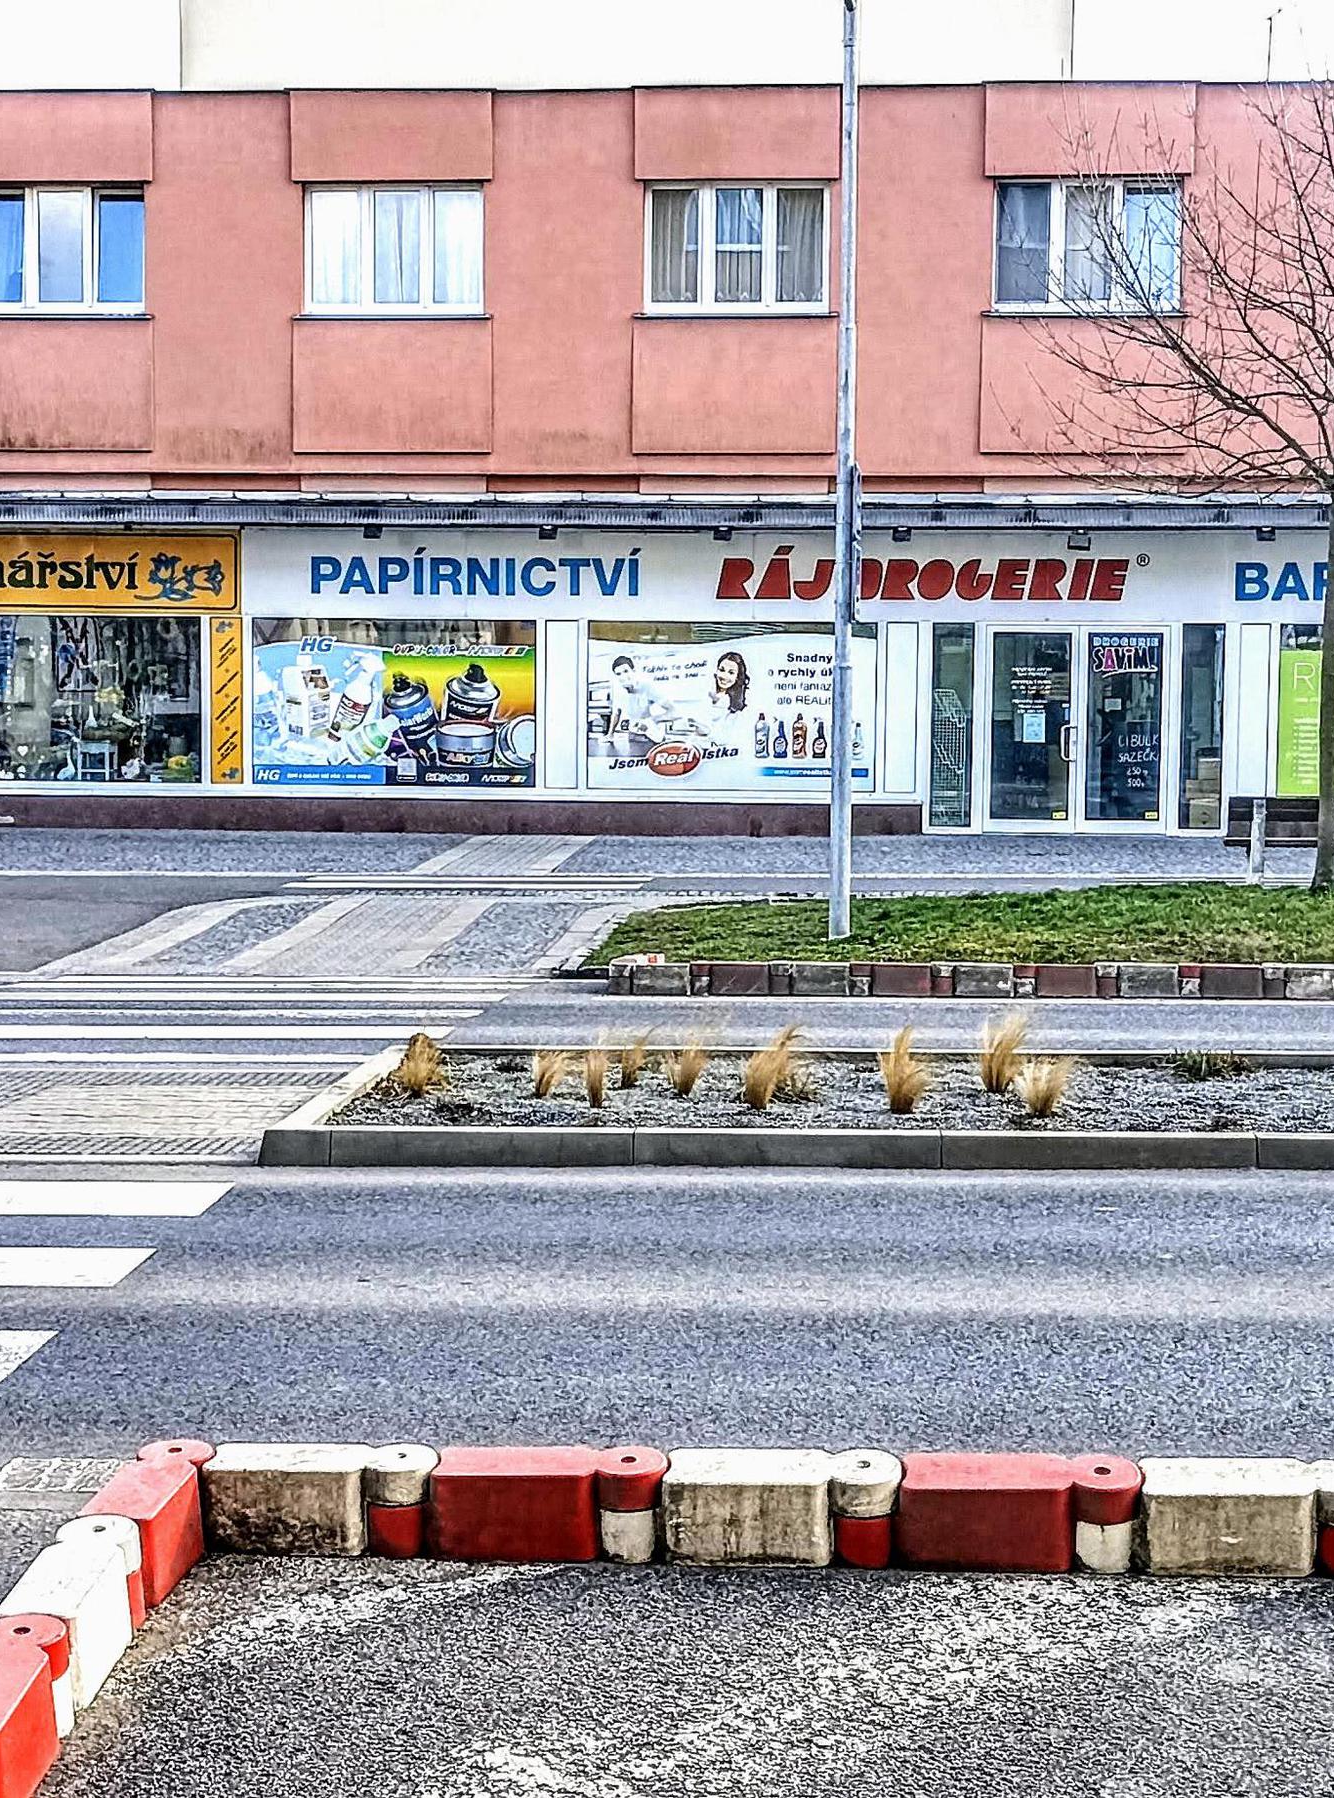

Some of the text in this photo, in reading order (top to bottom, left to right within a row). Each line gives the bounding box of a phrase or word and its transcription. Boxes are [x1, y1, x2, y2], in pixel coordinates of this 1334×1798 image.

[310, 547, 642, 597] PAPÍRNICTVÍ
[716, 545, 835, 600] RÁJ
[300, 637, 333, 652] HG
[1118, 734, 1159, 747] CIBULK
[257, 769, 281, 780] HG
